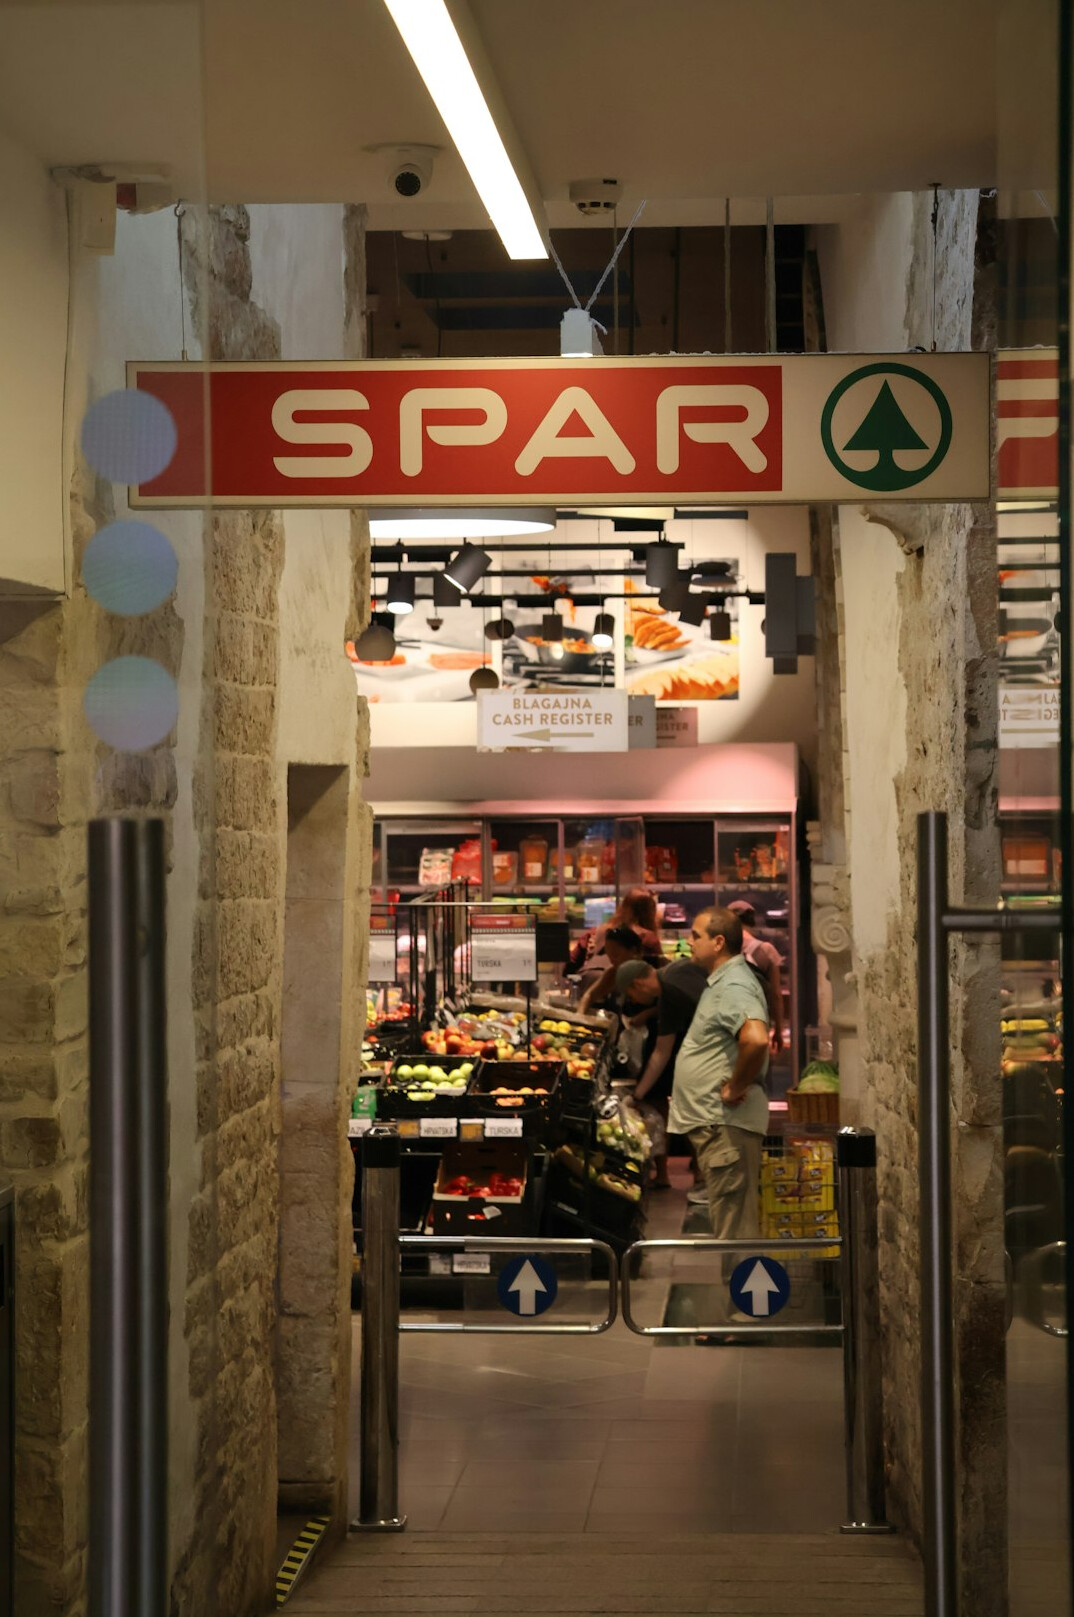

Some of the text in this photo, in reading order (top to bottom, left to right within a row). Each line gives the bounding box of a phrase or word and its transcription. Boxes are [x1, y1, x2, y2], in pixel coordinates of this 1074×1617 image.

[271, 384, 769, 479] SPAR
[512, 697, 593, 710] BLAGAJNA
[492, 712, 613, 726] CASH REGISTER
[489, 1126, 519, 1135] TURSKA
